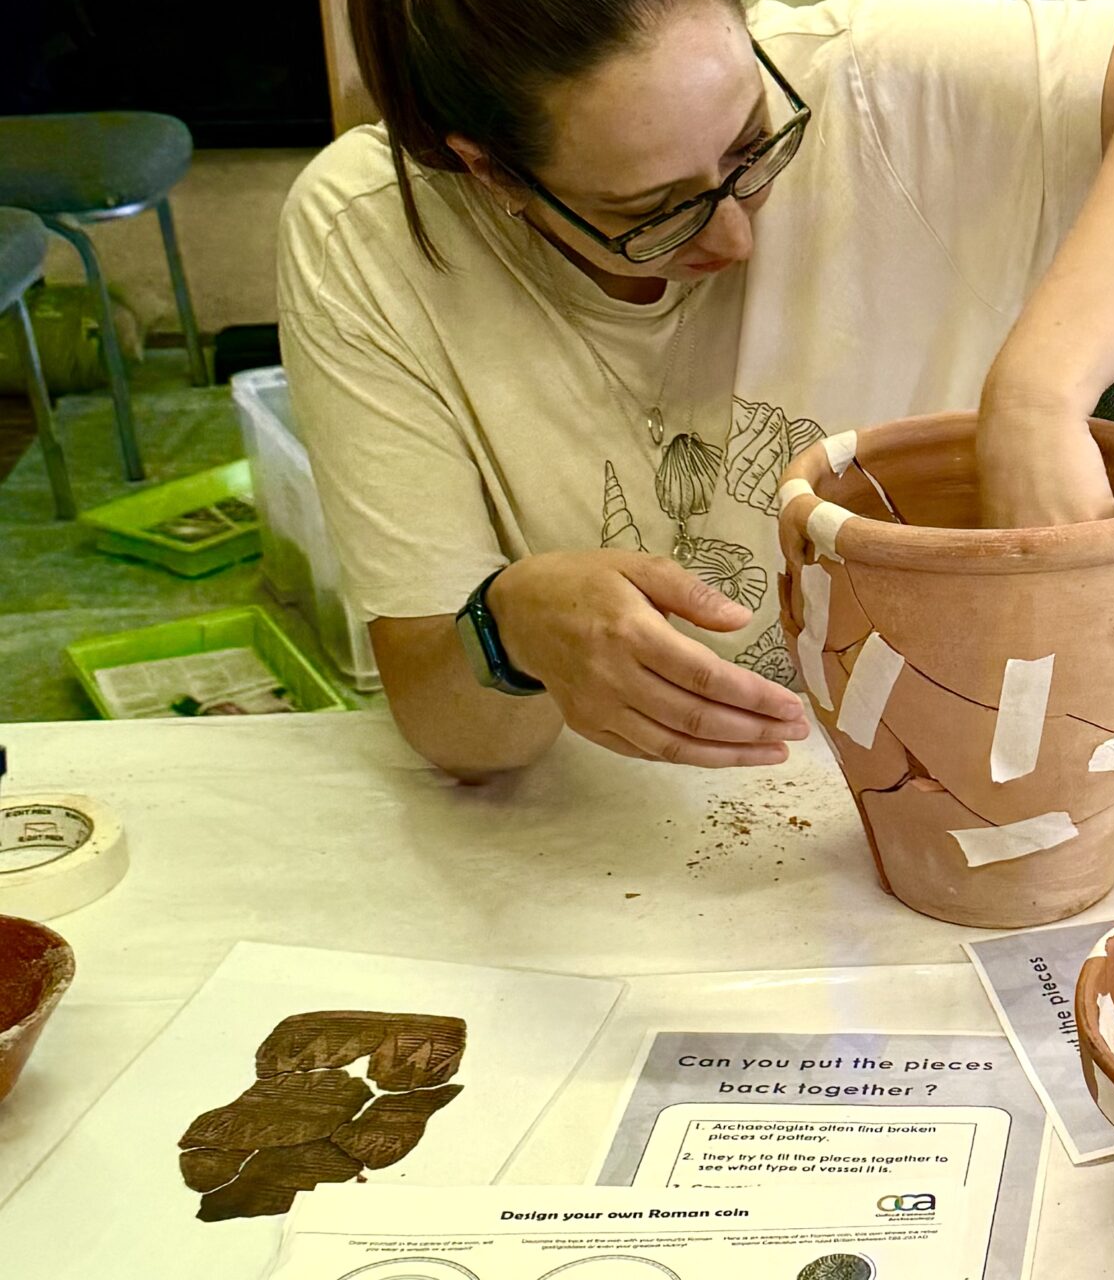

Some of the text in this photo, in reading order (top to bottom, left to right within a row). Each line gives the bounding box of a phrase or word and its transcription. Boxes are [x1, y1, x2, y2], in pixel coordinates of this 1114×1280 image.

[1029, 956, 1070, 1006] pieces
[1057, 1010, 1078, 1034] the
[678, 1055, 994, 1072] Can you put the pieces
[719, 1081, 938, 1098] back together ?
[712, 1123, 815, 1133] Archaeologists
[819, 1124, 855, 1132] often
[858, 1125, 883, 1133] find
[887, 1125, 937, 1133] broken
[708, 1133, 756, 1142] pieces
[760, 1133, 773, 1141] of
[703, 1153, 735, 1163] They
[739, 1154, 757, 1163] try
[794, 1154, 816, 1162] the
[819, 1154, 868, 1164] pieces
[871, 1154, 931, 1165] together
[935, 1155, 949, 1163] to
[766, 1164, 798, 1173] type
[802, 1164, 816, 1172] of
[819, 1165, 864, 1173] vessel
[500, 1207, 750, 1222] Design your own Roman coin
